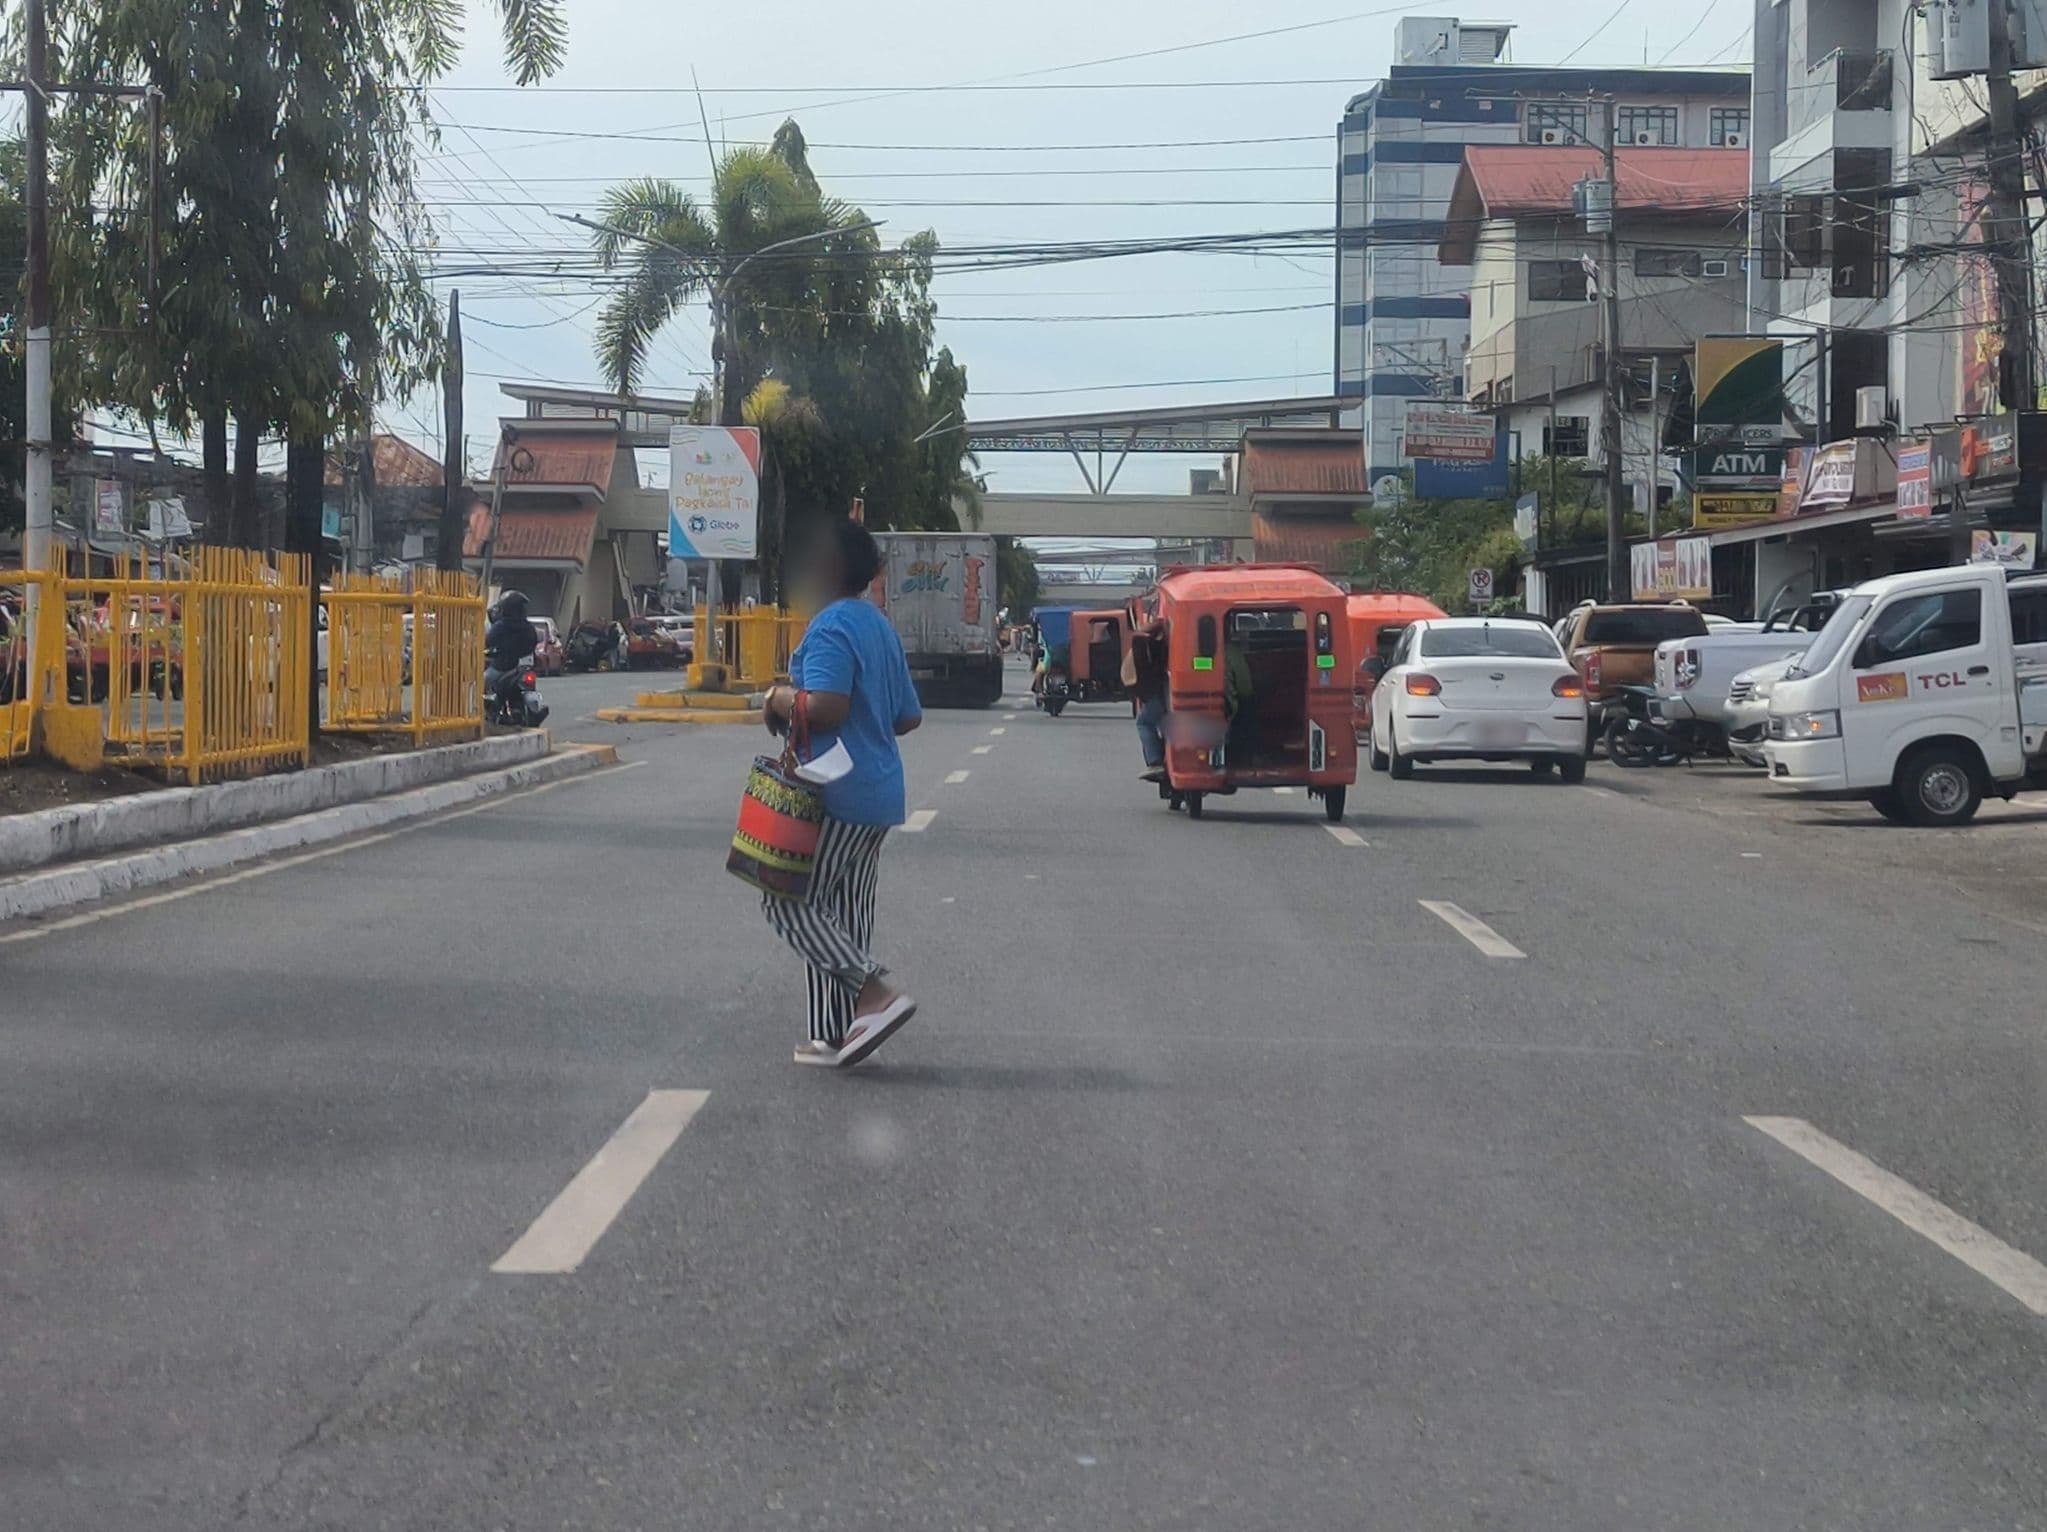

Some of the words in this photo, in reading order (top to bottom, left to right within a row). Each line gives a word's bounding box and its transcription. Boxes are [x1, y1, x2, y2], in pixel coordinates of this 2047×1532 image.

[1711, 454, 1766, 473] ATM
[709, 519, 740, 530] Globe
[1917, 671, 1967, 690] TCL
